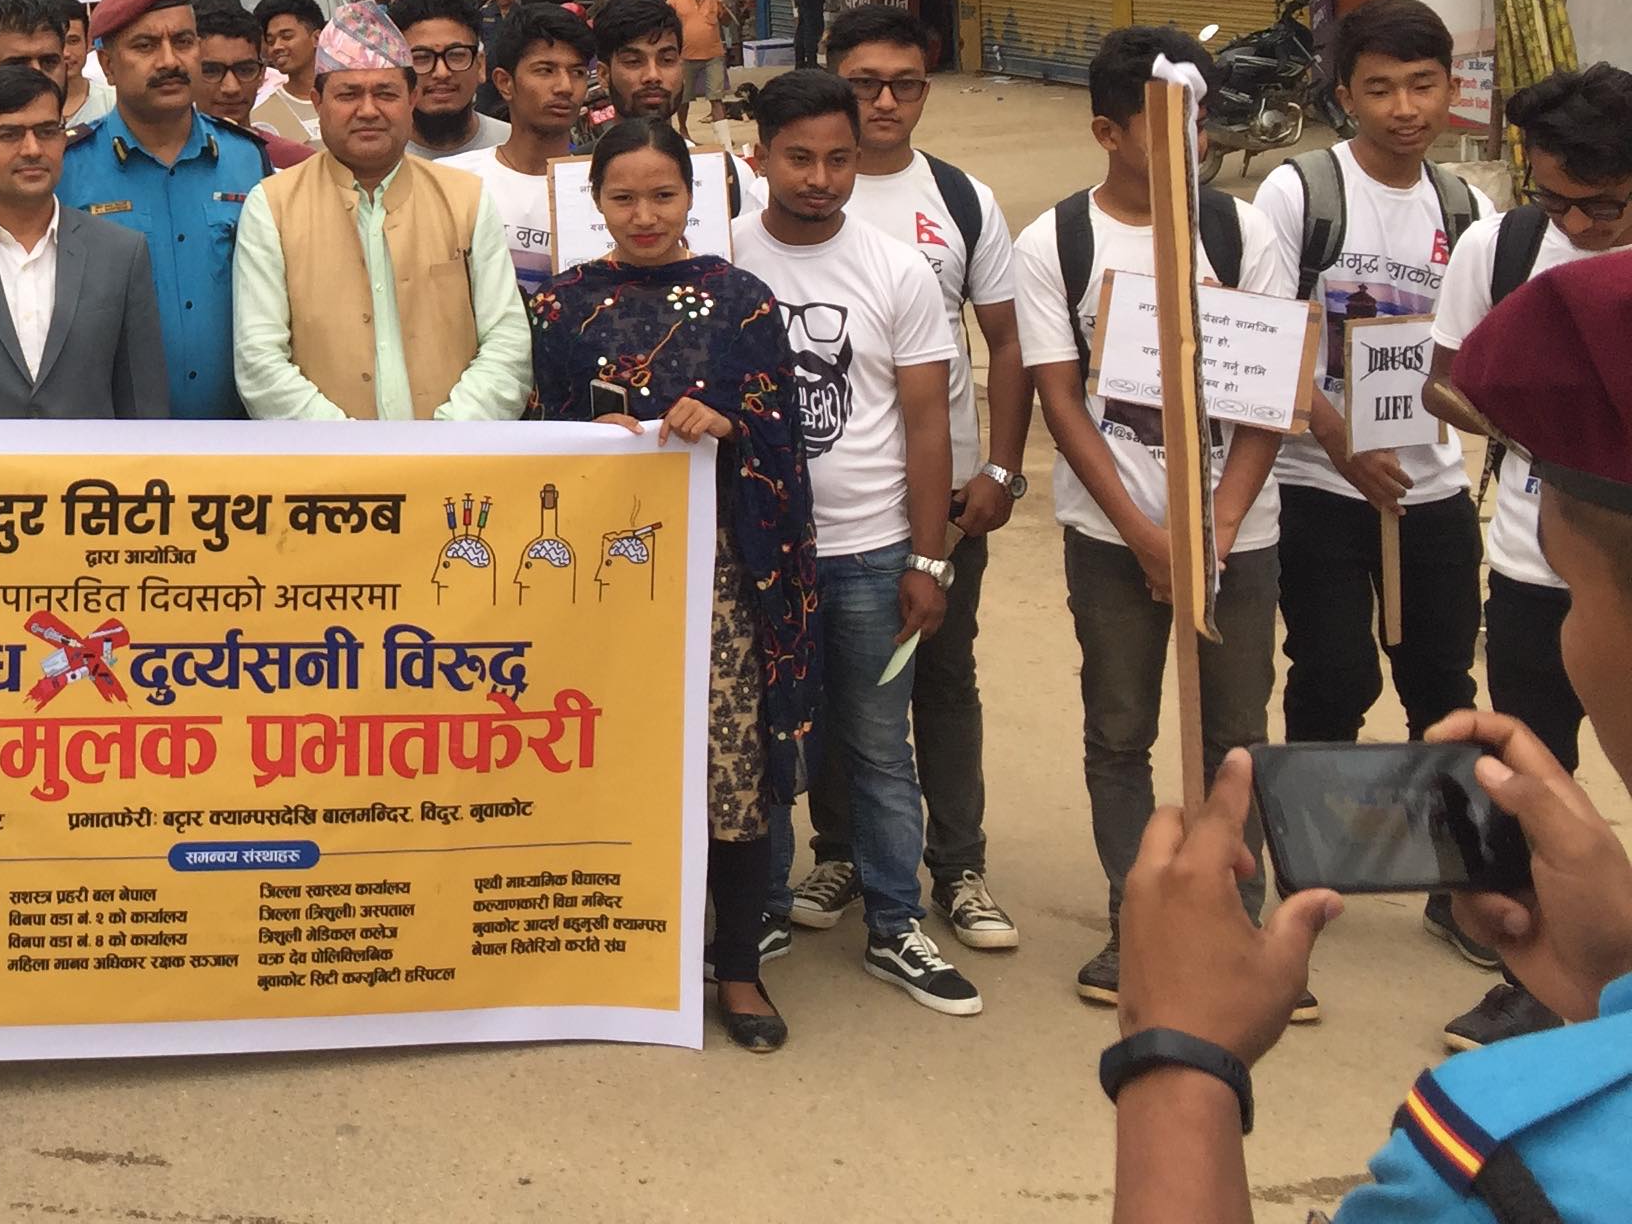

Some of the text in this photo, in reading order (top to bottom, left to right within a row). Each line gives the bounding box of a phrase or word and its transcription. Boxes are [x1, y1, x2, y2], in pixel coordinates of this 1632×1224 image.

[1368, 345, 1424, 372] DRUGS
[1375, 395, 1413, 421] LIFE
[61, 478, 175, 537] सिटी
[188, 494, 273, 552] युथ
[284, 493, 406, 535] क्लब
[85, 545, 196, 568] द्वारा आयोजित
[137, 576, 265, 612] दिवसको
[274, 582, 402, 611] अवसरमा
[246, 688, 603, 788] प्रभातफेरी
[163, 810, 203, 834] बट्टार
[209, 804, 318, 827] क्याम्पसदेखि
[469, 798, 534, 823] नुवाकोट
[185, 851, 237, 864] समन्वय
[259, 882, 301, 899] जिल्ला
[356, 879, 411, 895] कार्यालय
[474, 870, 621, 894] पृथ्वी विद्यालय
[9, 885, 157, 904] सशस्त्र प्रहरी बल नेपाल
[473, 891, 623, 912] कल्याणकारी विद्या मन्दिर
[50, 912, 73, 925] वडा
[96, 913, 104, 924] २
[109, 908, 126, 924] को
[131, 908, 188, 923] कार्यालय
[259, 905, 300, 921] जिल्ला
[360, 903, 415, 918] अस्पताल
[258, 924, 398, 946] त्रिशुली मेडिकल कलेज
[473, 917, 520, 937] नुवाकोट
[524, 915, 559, 932] आदर्श
[613, 918, 667, 933] क्याम्पस
[50, 934, 72, 948] वडा
[109, 931, 126, 947] को
[131, 930, 188, 945] कार्यालय
[472, 939, 507, 956] नेपाल
[604, 937, 626, 954] संघ
[8, 954, 49, 972] महिला
[54, 956, 89, 970] मानव
[93, 953, 146, 969] अधिकार
[151, 955, 185, 969] रक्षक
[289, 949, 307, 964] देव
[258, 971, 306, 991] नुवाकोट
[310, 969, 338, 987] सिटी
[342, 967, 400, 987] कम्युनिटी
